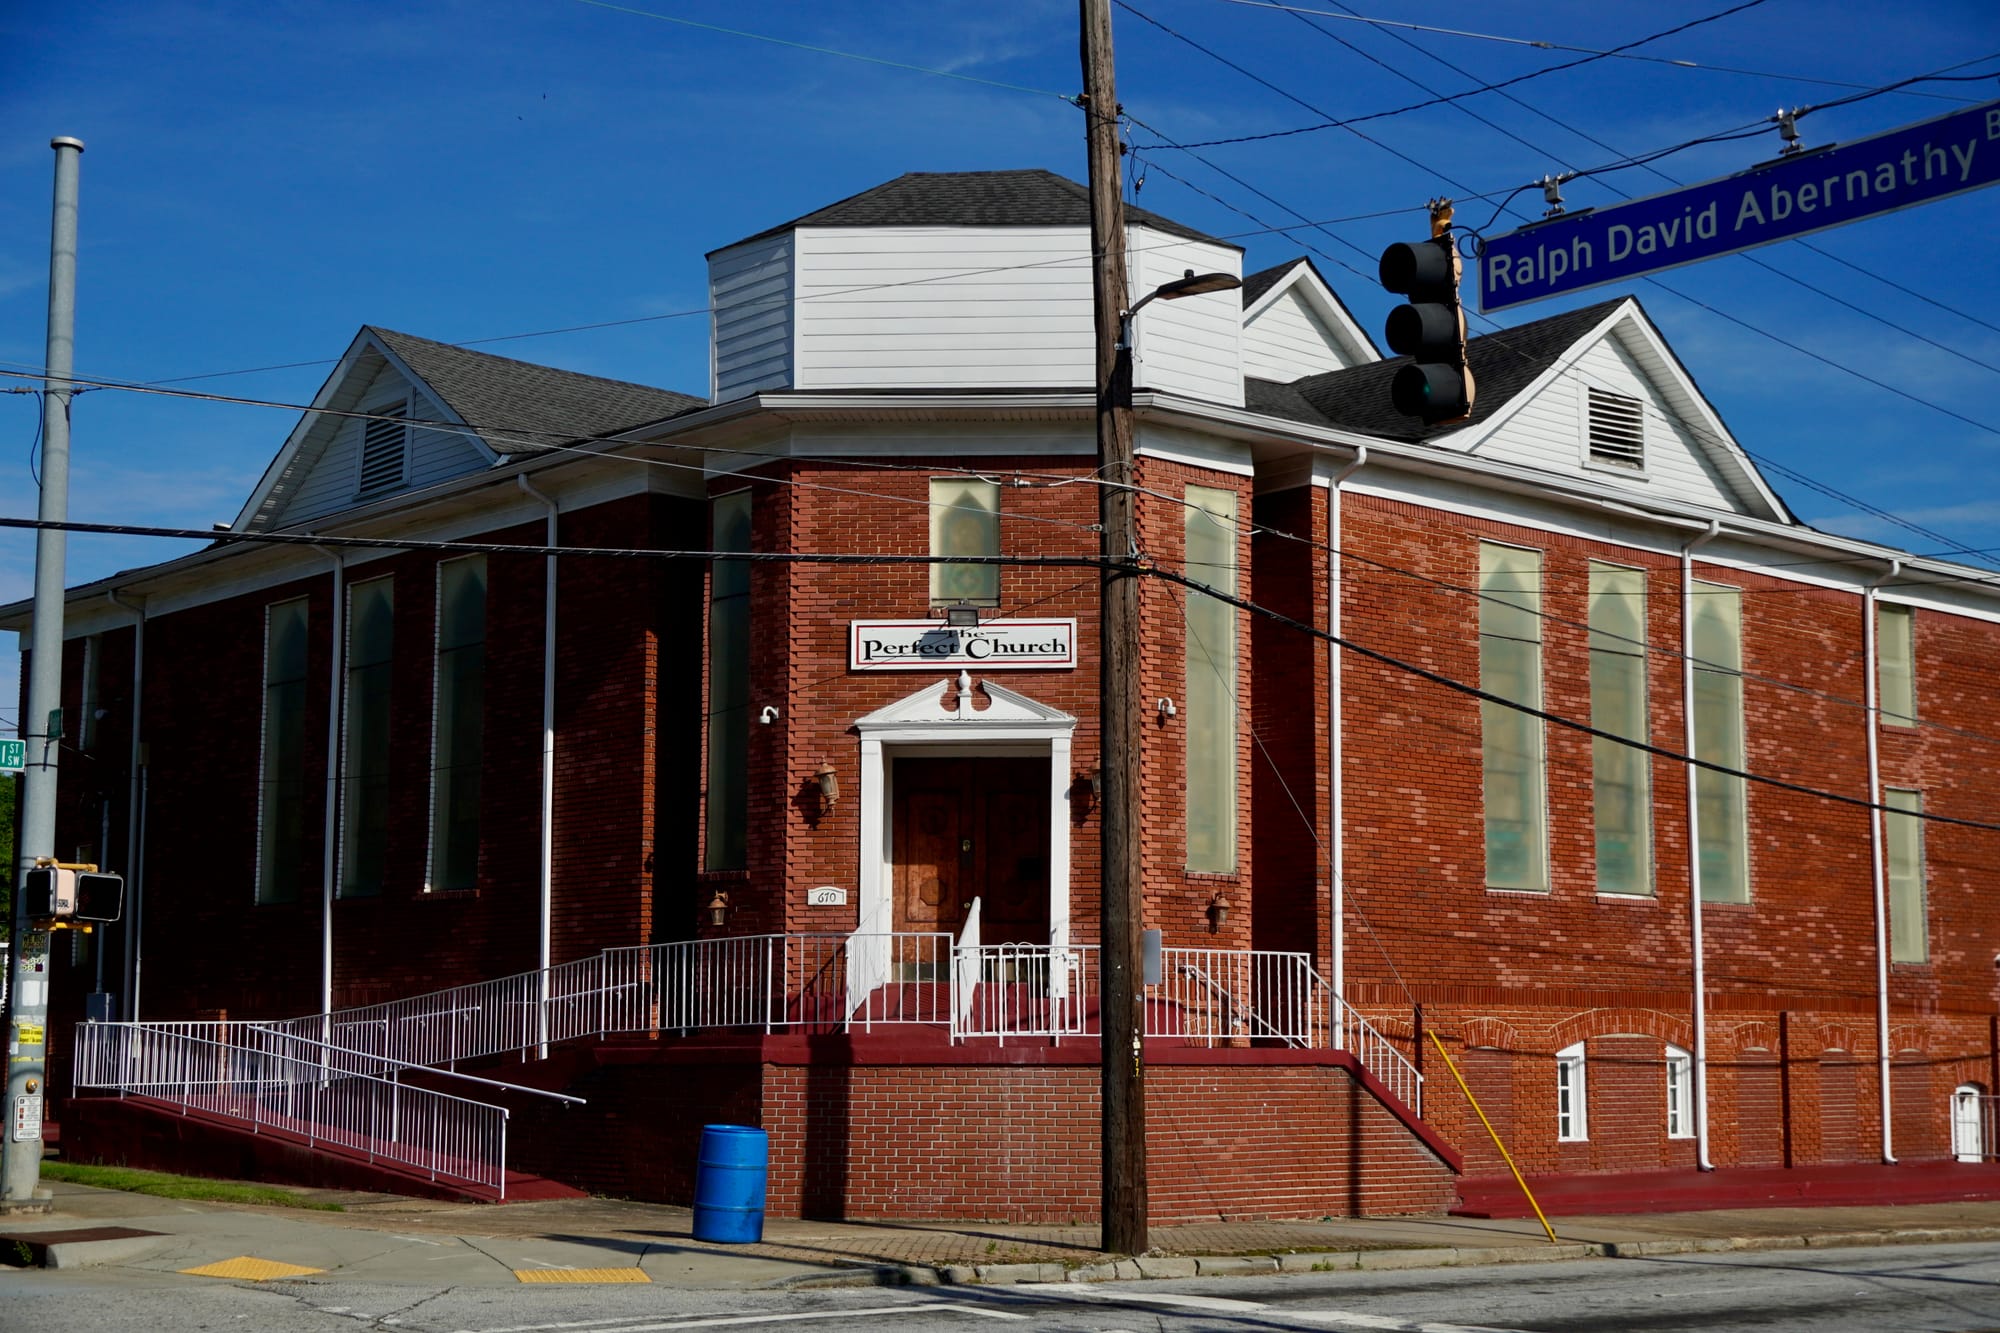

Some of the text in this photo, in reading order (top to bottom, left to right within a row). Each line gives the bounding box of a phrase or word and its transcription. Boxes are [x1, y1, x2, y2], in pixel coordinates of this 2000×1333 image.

[1489, 235, 1593, 292] Ralph
[1608, 202, 1717, 262] David
[1734, 138, 1977, 231] Abernathy
[946, 629, 984, 638] The
[863, 638, 1067, 660] Perfect Church
[10, 743, 19, 754] ST
[8, 755, 19, 766] SW
[818, 892, 836, 903] 670
